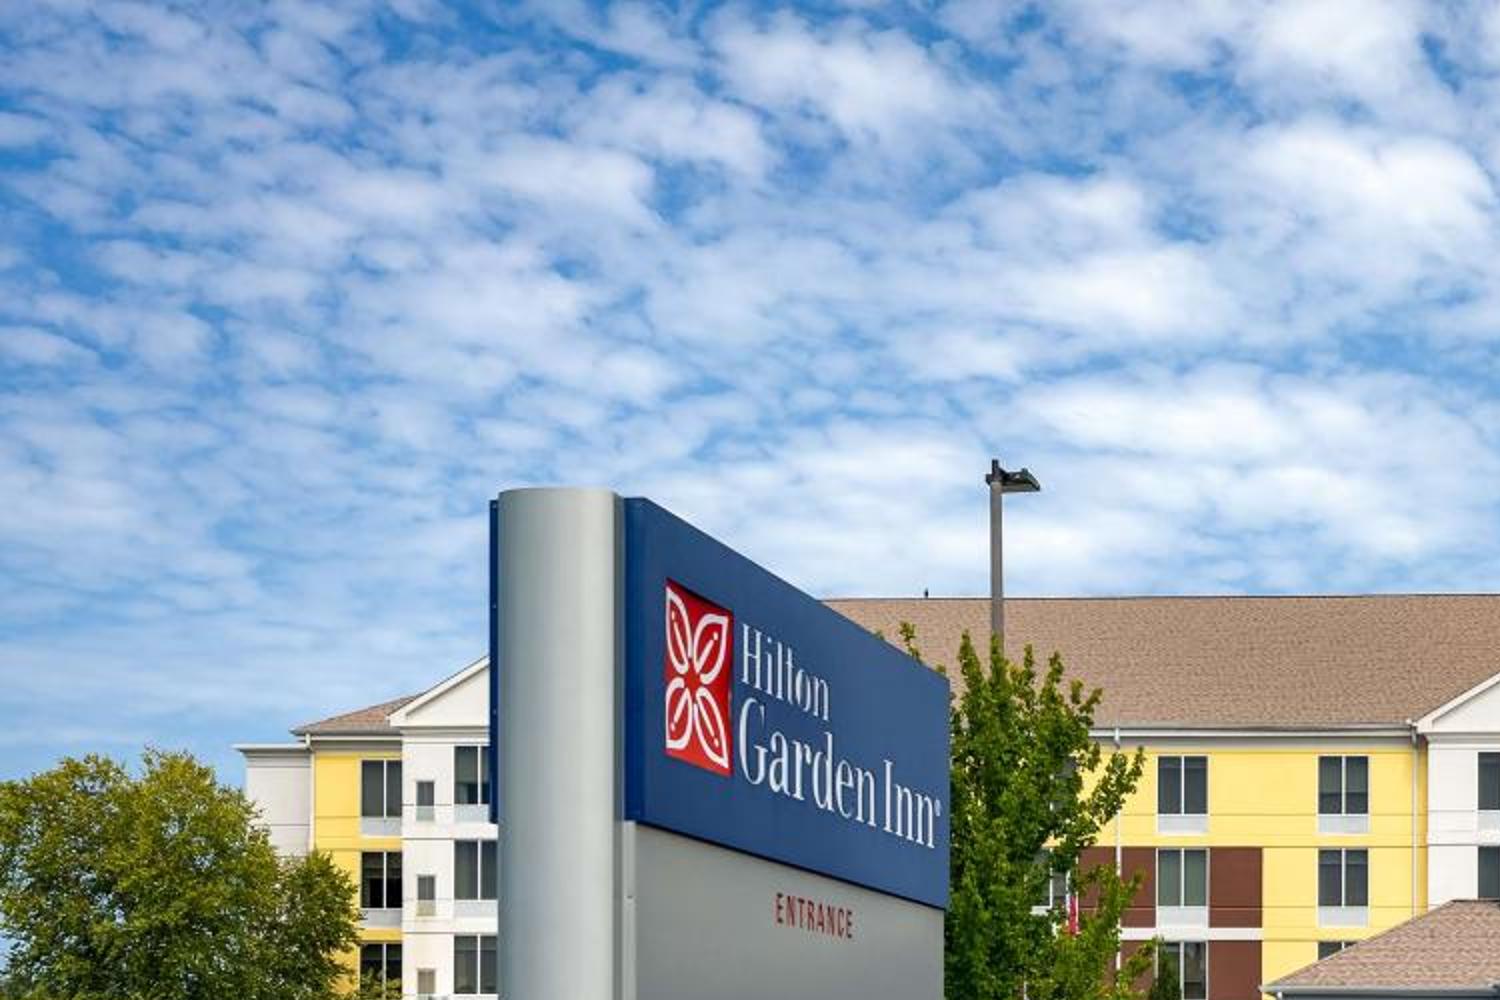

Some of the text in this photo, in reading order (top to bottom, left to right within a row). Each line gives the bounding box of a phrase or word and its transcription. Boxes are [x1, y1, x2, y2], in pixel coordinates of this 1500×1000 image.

[741, 623, 829, 721] Hilton
[739, 697, 935, 849] Garden Inn
[776, 892, 853, 939] ENTRANCE
